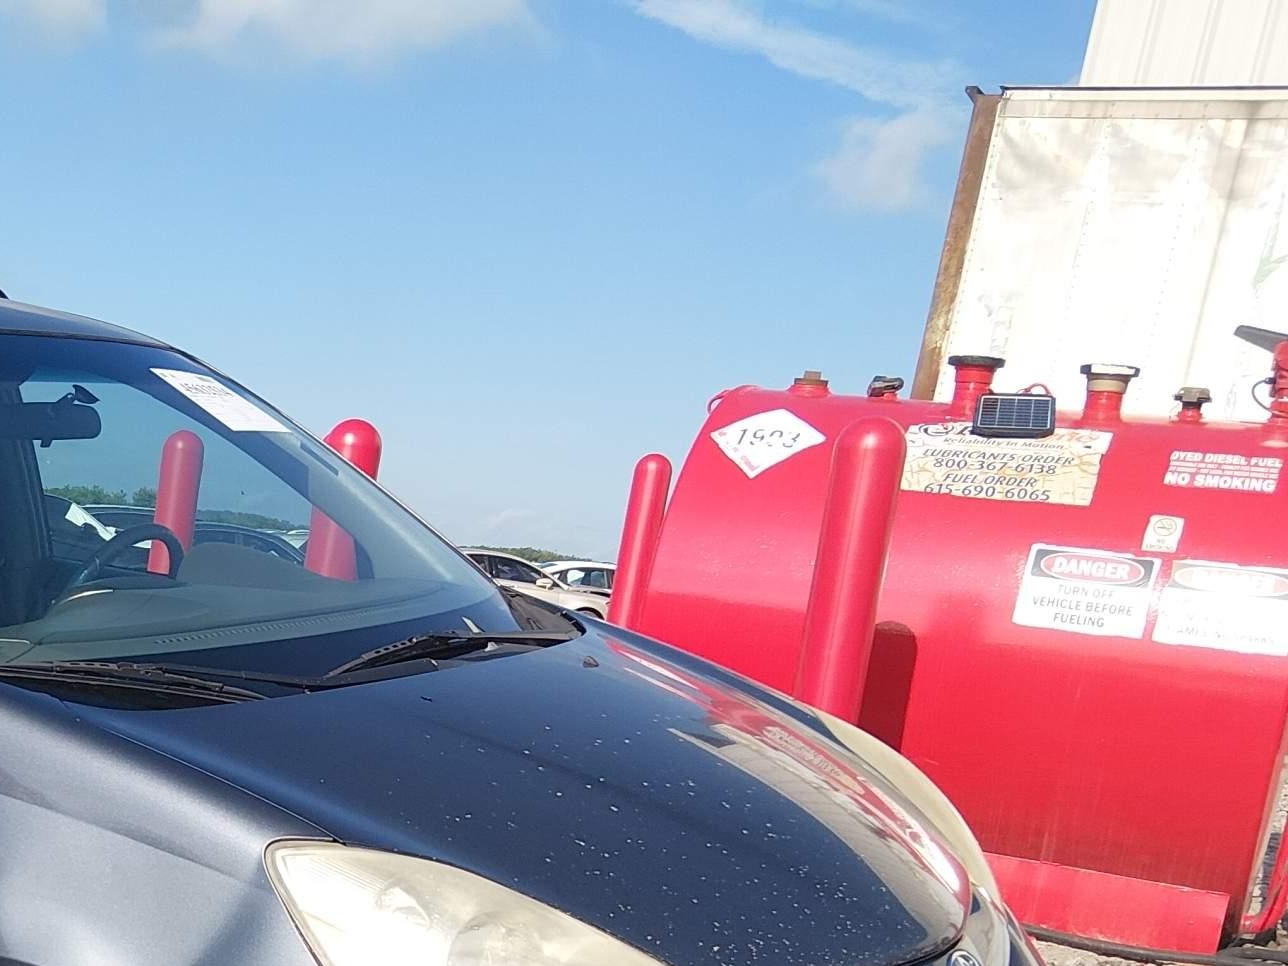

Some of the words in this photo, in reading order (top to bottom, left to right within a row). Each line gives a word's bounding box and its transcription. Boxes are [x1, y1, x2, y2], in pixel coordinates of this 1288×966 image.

[922, 448, 1016, 462] LUBRICANTS
[1021, 454, 1075, 466] ORDER
[1169, 450, 1203, 462] DYED
[1204, 452, 1249, 465] DIESEL
[1250, 456, 1284, 468] FUEL
[932, 458, 1058, 475] 800-367-6138
[943, 472, 982, 484] FUEL
[984, 475, 1038, 488] ORDER
[1163, 471, 1191, 486] NO
[1193, 473, 1278, 493] SMOKING
[923, 482, 1051, 501] 615-690-6065
[1052, 556, 1130, 580] DANGER
[1058, 584, 1088, 597] TURN
[1092, 588, 1116, 598] OFF
[1032, 595, 1081, 611] VEHICLE
[1085, 601, 1134, 617] BEFORE
[1053, 612, 1105, 628] FUELING
